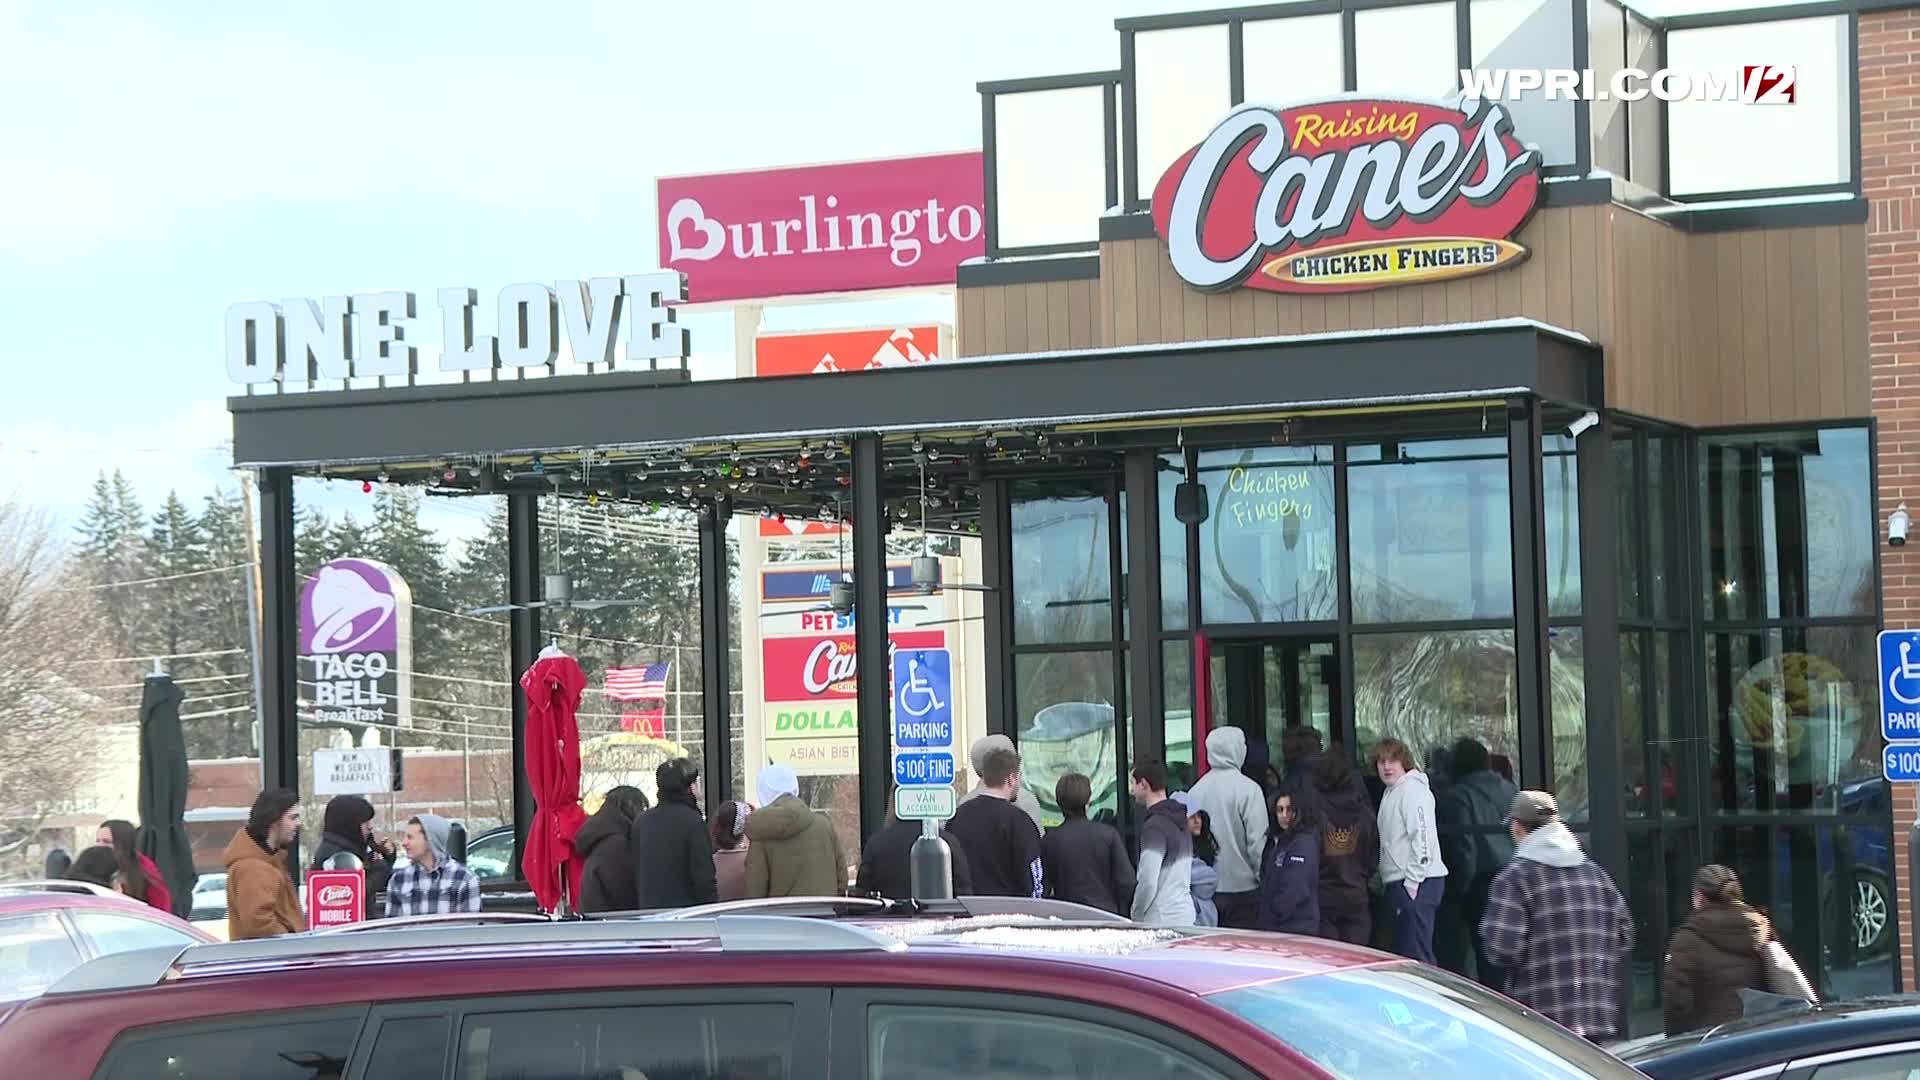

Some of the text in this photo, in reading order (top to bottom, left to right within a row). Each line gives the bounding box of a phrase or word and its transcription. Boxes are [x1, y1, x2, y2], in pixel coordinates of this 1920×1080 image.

[1293, 106, 1418, 150] Raising
[1167, 90, 1537, 288] Cane's
[667, 195, 985, 267] Burlingto
[1290, 245, 1496, 279] CHICKEN FINGERS
[225, 271, 689, 384] ONE LOVE
[1228, 467, 1310, 494] Chicken
[311, 652, 388, 680] TACO
[315, 680, 387, 706] BELL
[315, 706, 384, 722] Breakfast
[775, 709, 858, 732] DOLLA
[898, 722, 949, 739] PARKING
[789, 745, 857, 760] ASIAN BIST
[1887, 752, 1920, 773] $100
[897, 758, 953, 778] $100 FINE
[916, 792, 936, 803] VAN
[319, 909, 353, 922] MOBILE
